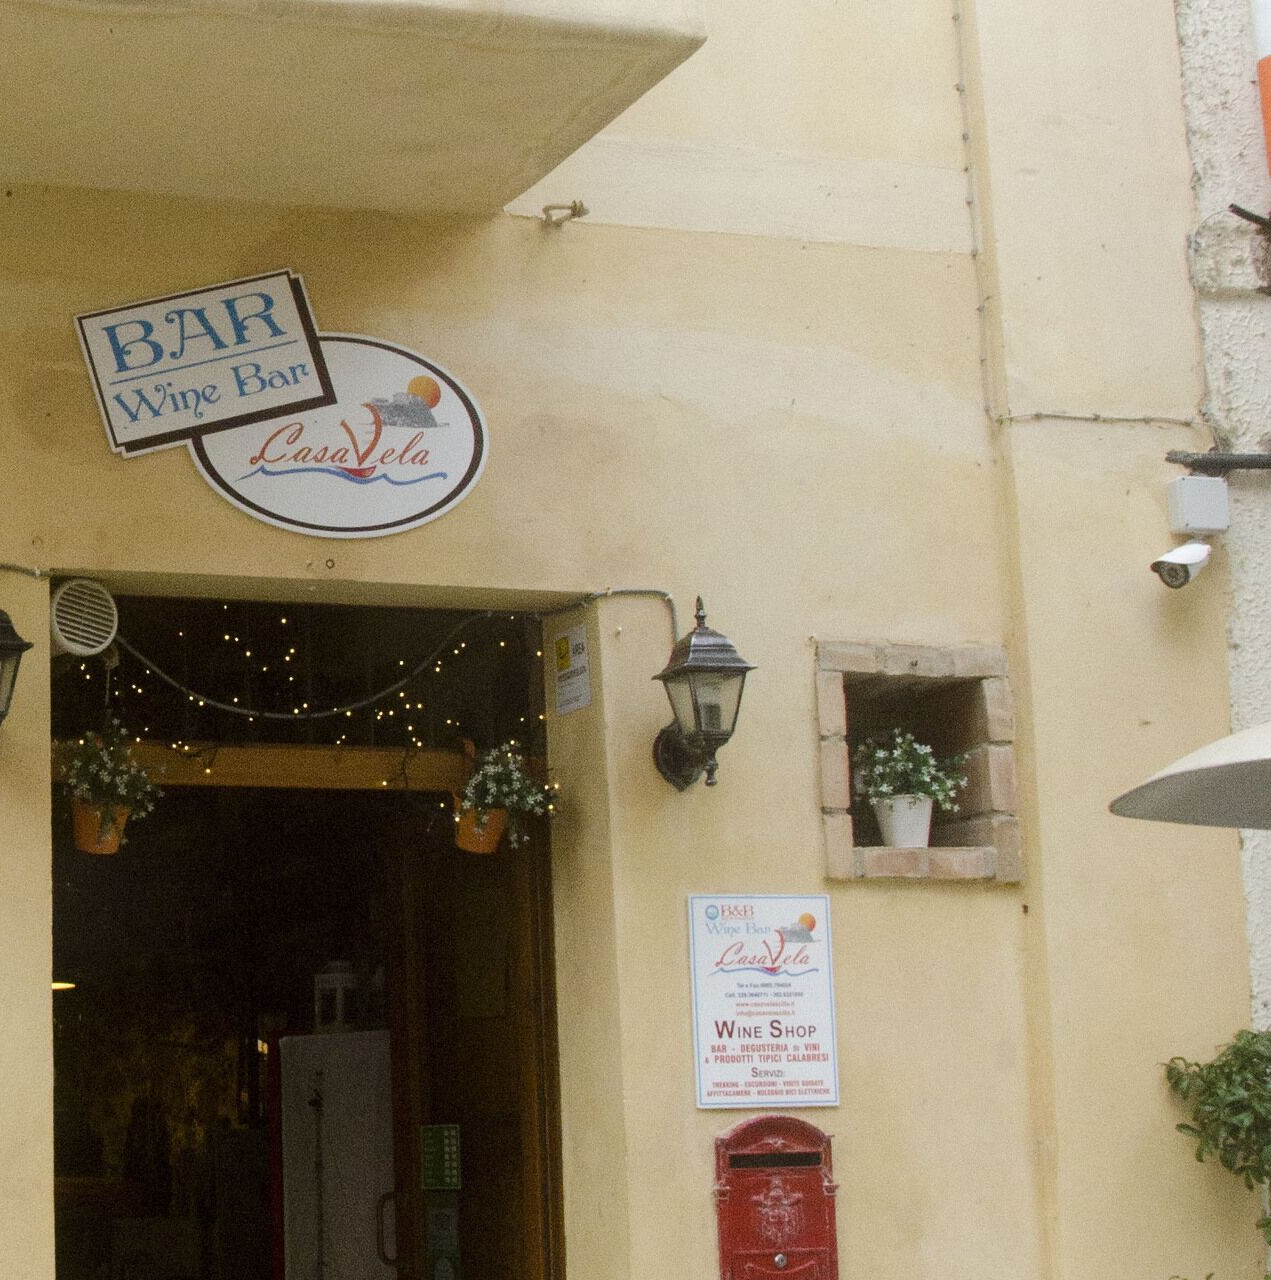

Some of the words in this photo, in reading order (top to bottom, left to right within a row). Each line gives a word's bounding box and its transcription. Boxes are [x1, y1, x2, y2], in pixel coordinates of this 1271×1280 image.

[101, 290, 289, 374] BAR
[112, 381, 221, 424] Wine
[229, 358, 311, 399] Bar
[721, 904, 754, 918] B&B
[705, 921, 741, 937] Wine
[710, 1044, 727, 1054] BAR
[740, 1043, 789, 1054] DEGUSTERIA
[803, 1043, 821, 1052] VINI
[714, 1054, 754, 1065] PRODOTTI
[758, 1054, 782, 1064] TIPICI
[786, 1052, 830, 1063] CALABRESI
